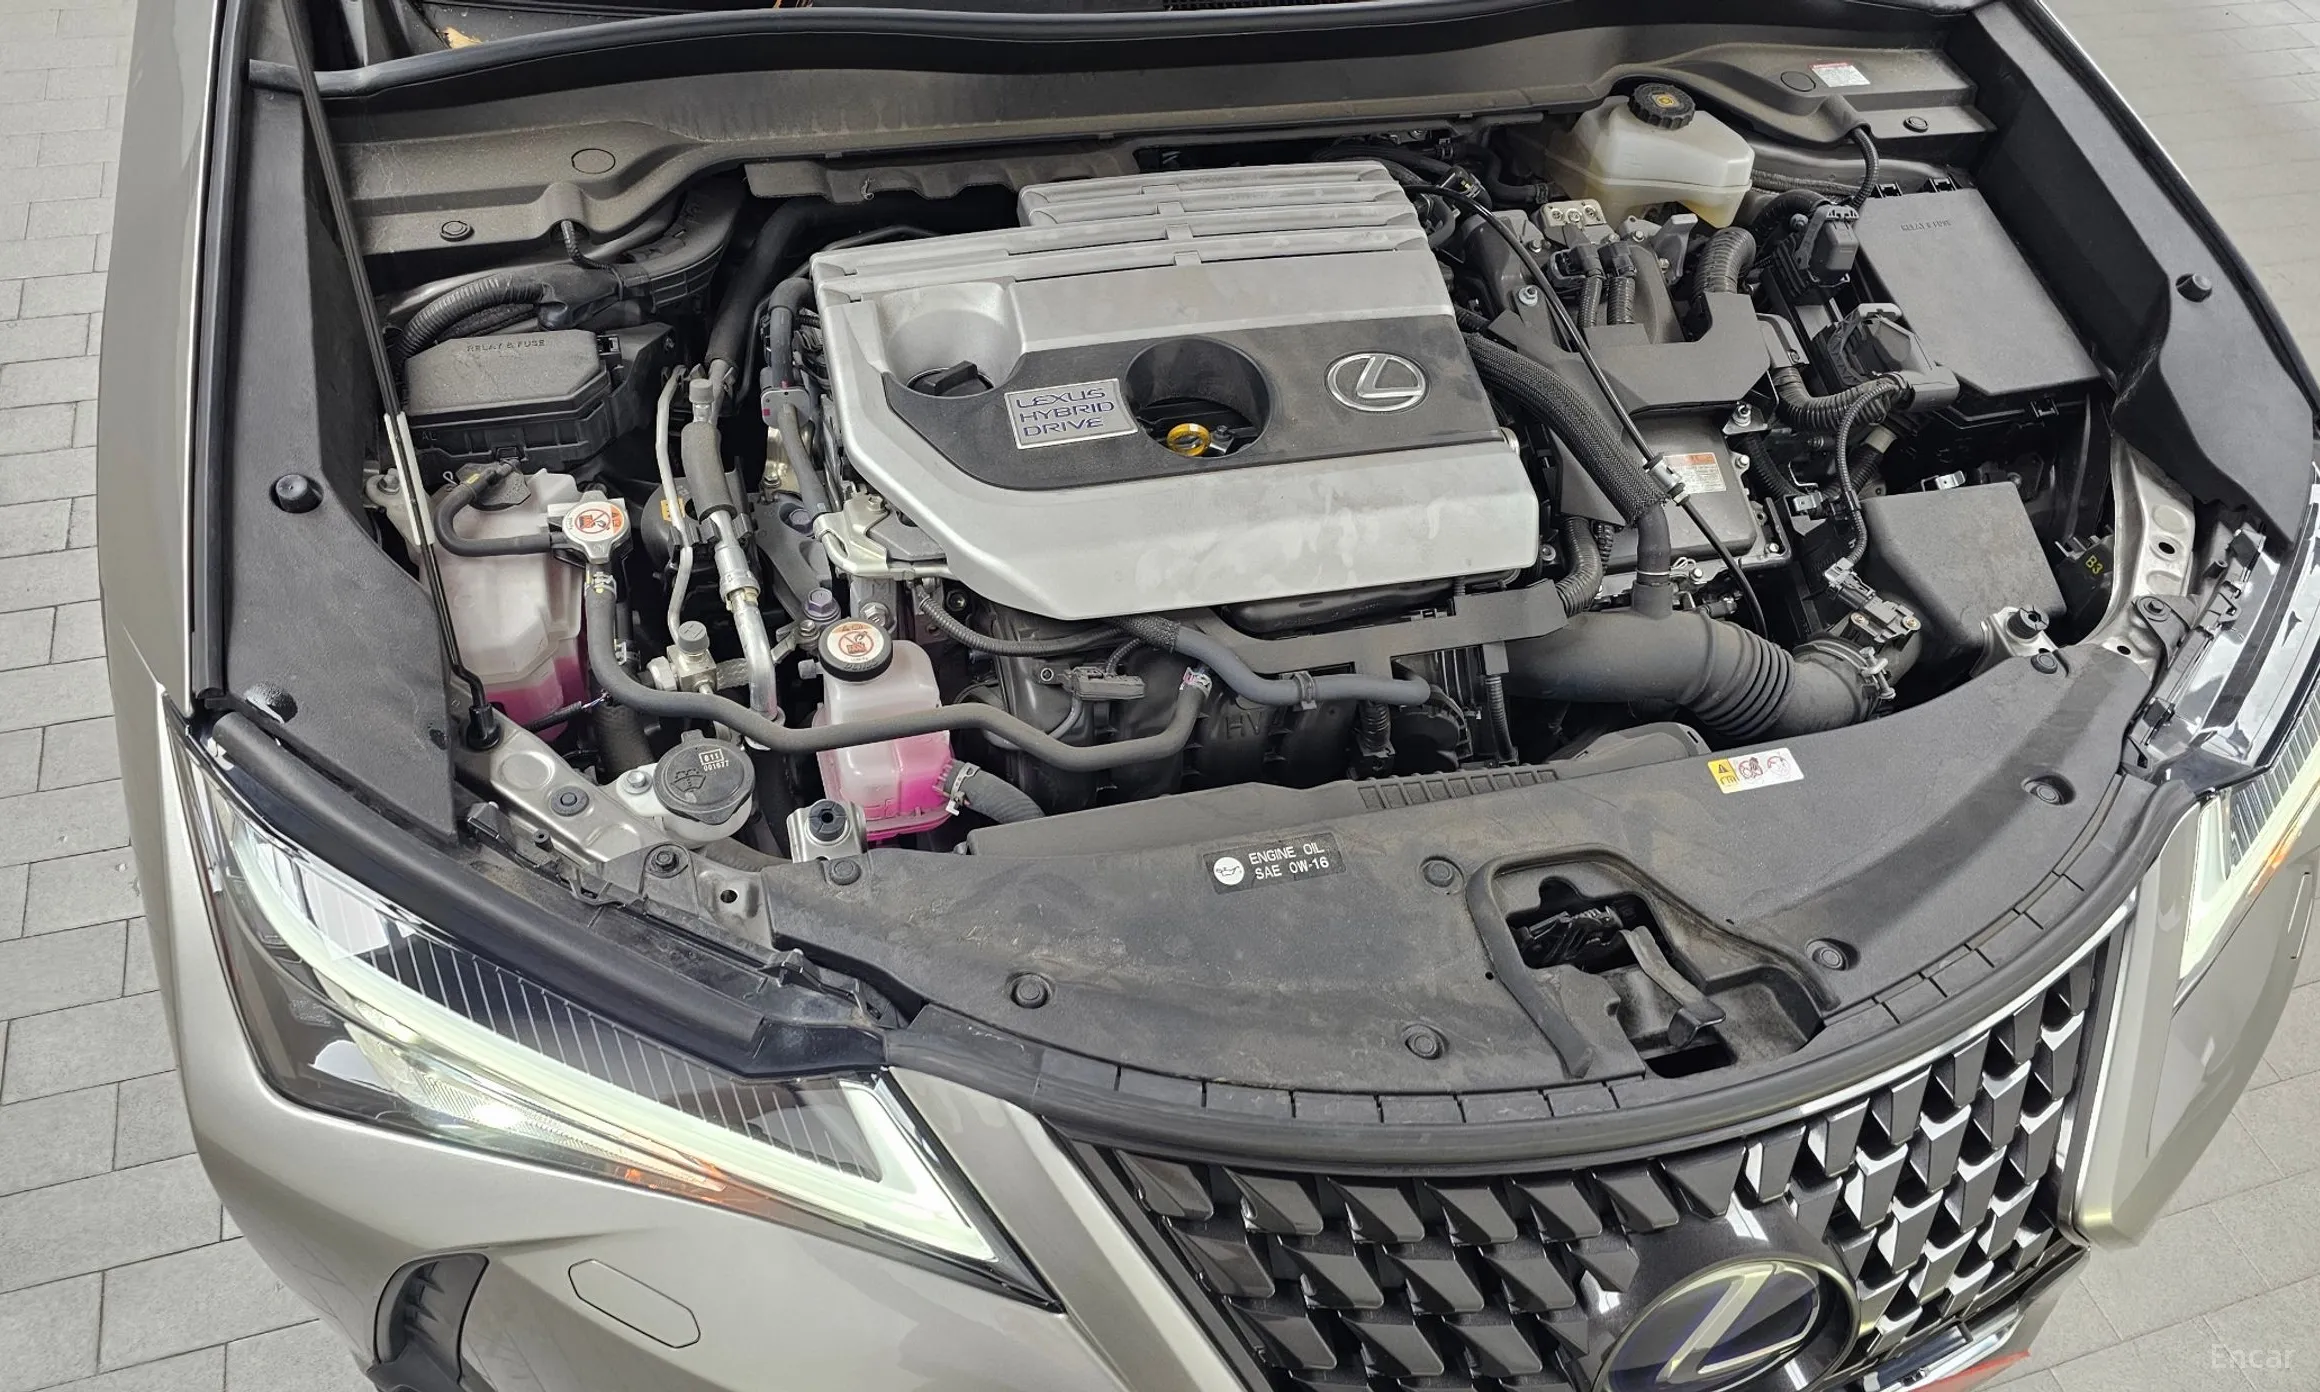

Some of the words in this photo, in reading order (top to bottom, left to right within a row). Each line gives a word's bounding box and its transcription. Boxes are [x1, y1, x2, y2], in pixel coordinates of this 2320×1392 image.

[1016, 387, 1105, 408] LEXUS
[1020, 401, 1115, 423] HYBRID
[1023, 417, 1104, 437] DRIVE
[2085, 554, 2104, 575] B3
[1248, 846, 1297, 865] ENGINE
[1302, 842, 1325, 856] OIL
[1255, 864, 1283, 880] SAE
[1289, 856, 1330, 874] 0W-16
